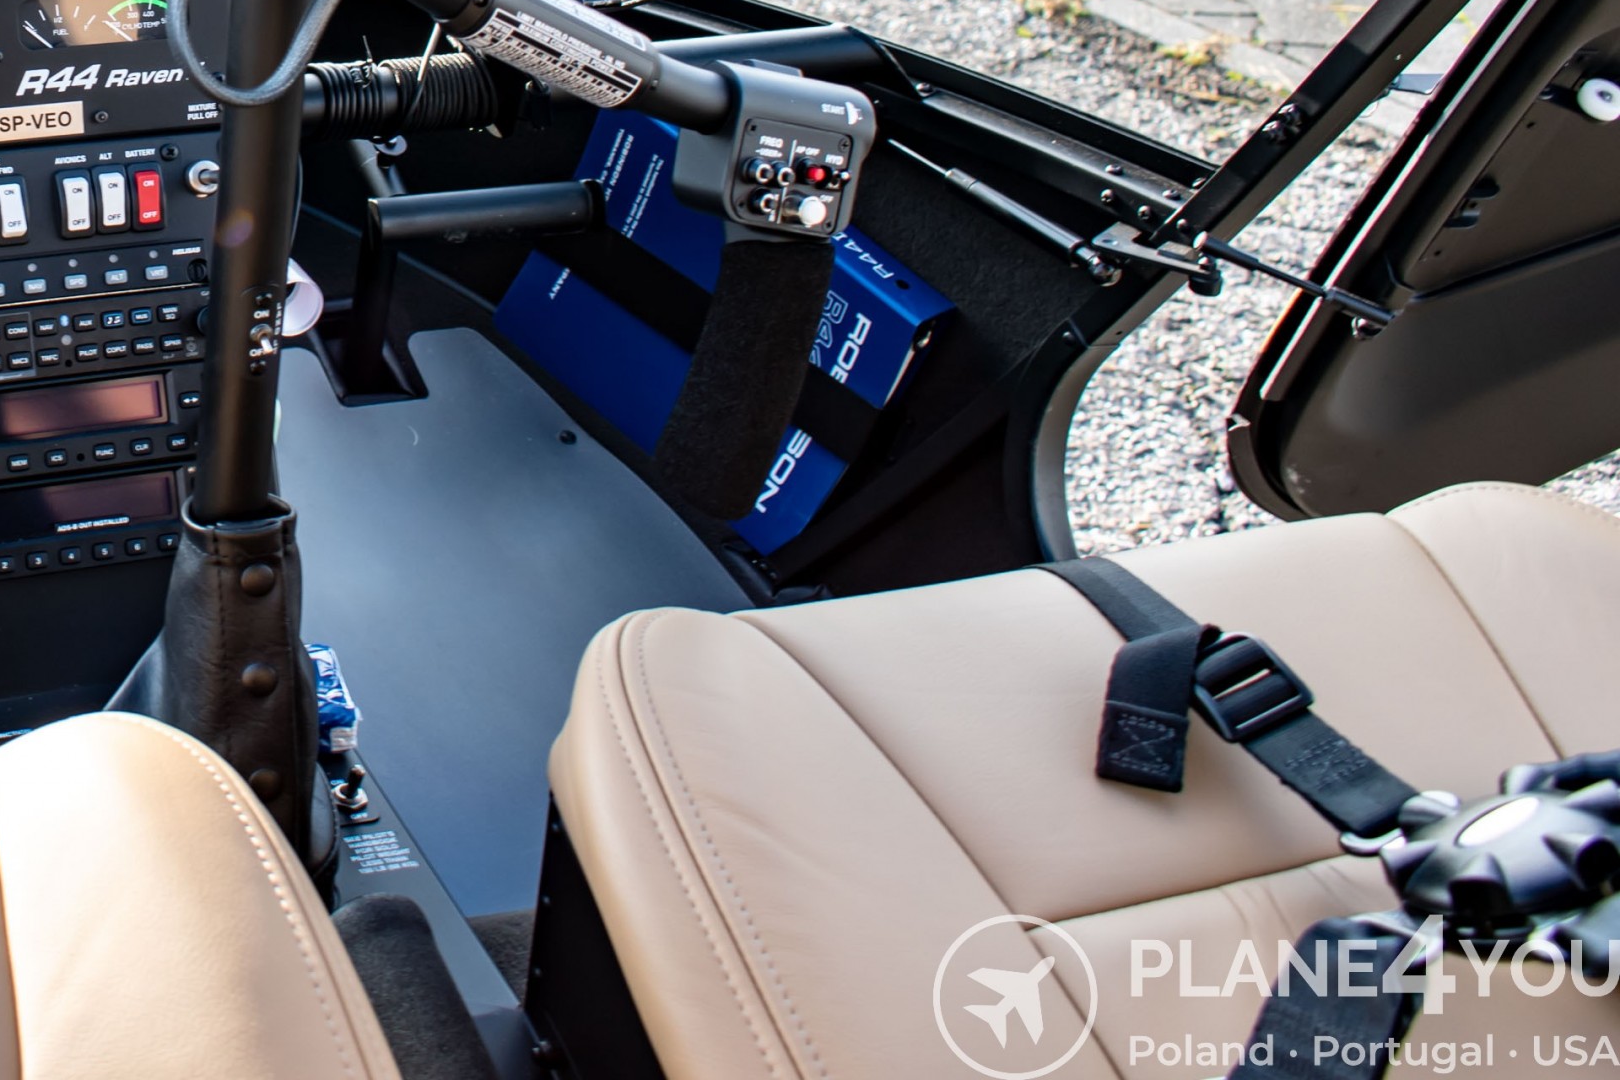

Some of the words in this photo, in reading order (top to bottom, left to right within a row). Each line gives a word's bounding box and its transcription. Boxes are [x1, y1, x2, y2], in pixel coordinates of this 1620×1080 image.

[16, 64, 101, 96] R44
[105, 68, 183, 88] Raven
[188, 103, 217, 112] MIXTURE
[821, 103, 845, 115] START
[187, 112, 204, 120] PULL
[205, 110, 218, 119] OFF
[0, 111, 72, 132] SP-VEO
[759, 135, 784, 148] FREQ
[99, 152, 113, 160] ALT
[125, 148, 155, 158] BATTERY
[55, 155, 87, 165] AVIONICS
[610, 134, 635, 186] ROBINSON
[825, 154, 844, 165] HYD
[108, 213, 121, 221] OFF
[143, 211, 158, 219] OFF
[8, 220, 22, 228] OFF
[72, 218, 86, 226] OFF
[254, 310, 270, 319] ON
[79, 348, 97, 357] PILOT
[57, 522, 77, 532] ADS-B
[80, 521, 92, 529] OUT
[93, 517, 129, 528] INSTALLED
